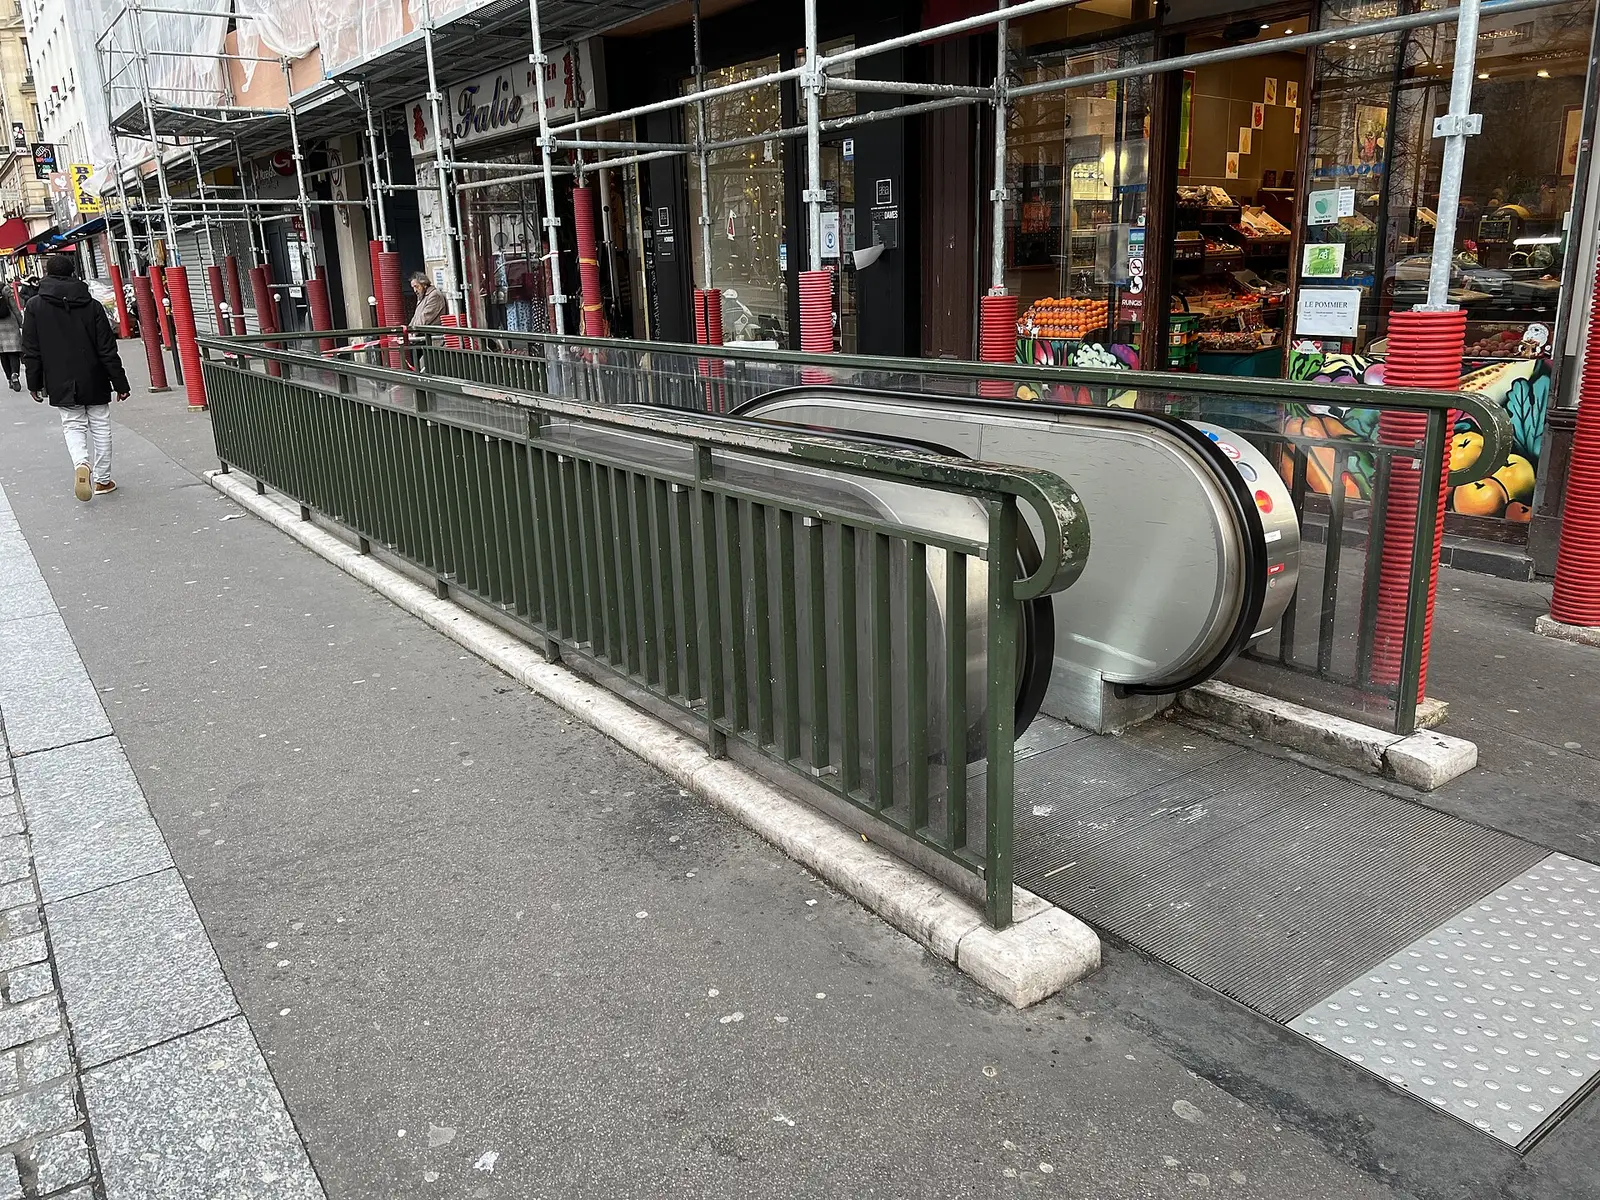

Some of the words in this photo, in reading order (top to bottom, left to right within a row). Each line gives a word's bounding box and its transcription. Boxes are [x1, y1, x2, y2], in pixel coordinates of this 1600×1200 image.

[526, 63, 557, 88] POTER
[456, 75, 524, 139] Falie
[74, 166, 96, 205] BAAR
[884, 210, 898, 220] DAMES
[1121, 299, 1143, 307] RUNGIS
